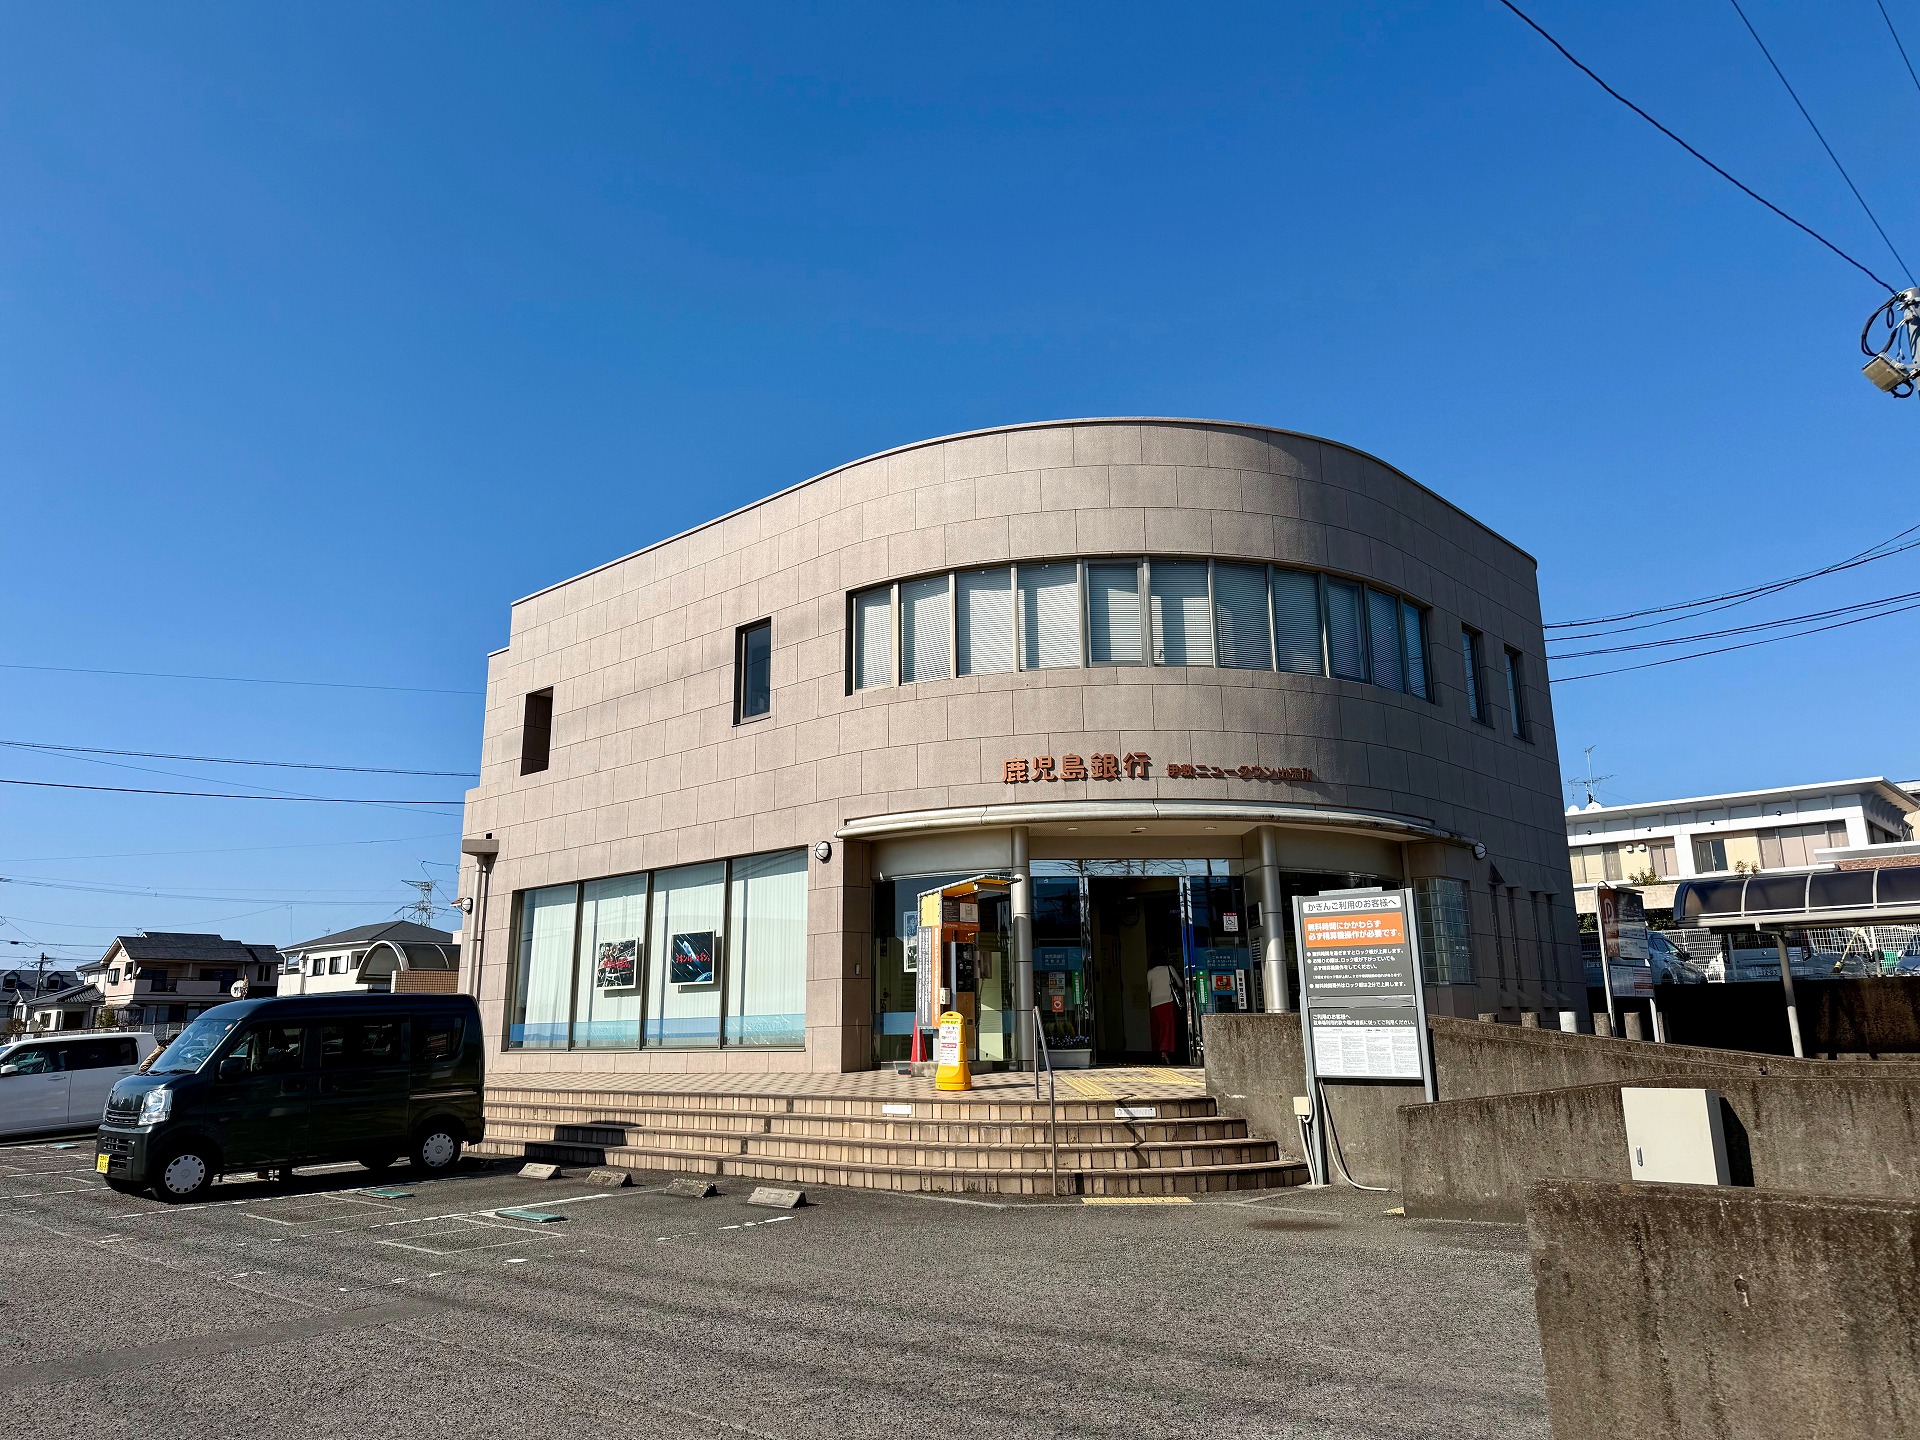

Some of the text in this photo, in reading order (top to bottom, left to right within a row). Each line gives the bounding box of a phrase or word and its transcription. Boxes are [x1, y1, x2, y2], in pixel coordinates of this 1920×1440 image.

[1003, 751, 1151, 783] 鹿児島銀行
[1308, 898, 1396, 911] かぎんご利用のお客様へ
[1307, 920, 1381, 932] 無料時間にかかわらず
[1308, 929, 1402, 941] 必ず精算機操作が必要です。
